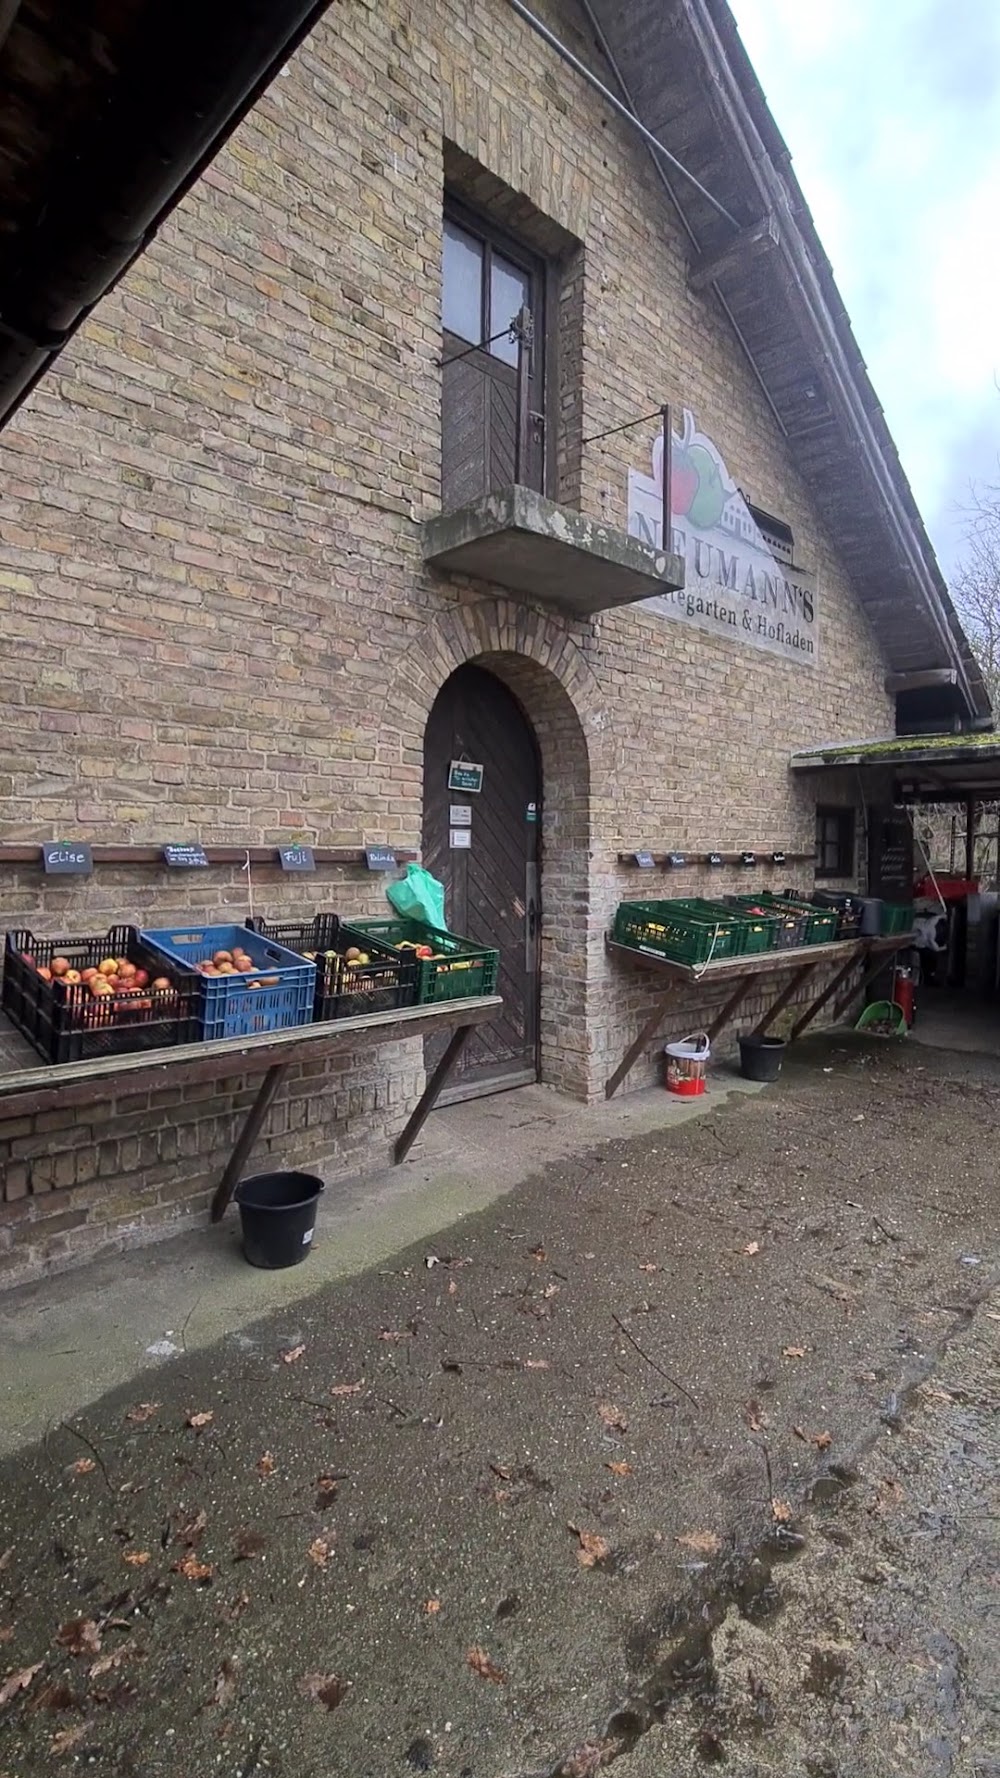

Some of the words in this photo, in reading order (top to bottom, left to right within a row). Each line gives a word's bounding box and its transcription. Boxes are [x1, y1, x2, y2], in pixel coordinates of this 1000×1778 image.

[636, 512, 814, 623] NEUMANN'S
[659, 591, 737, 626] tegarten
[742, 608, 752, 631] &
[756, 613, 814, 654] Hofladen
[48, 851, 85, 865] Elise
[283, 851, 307, 864] Fuji
